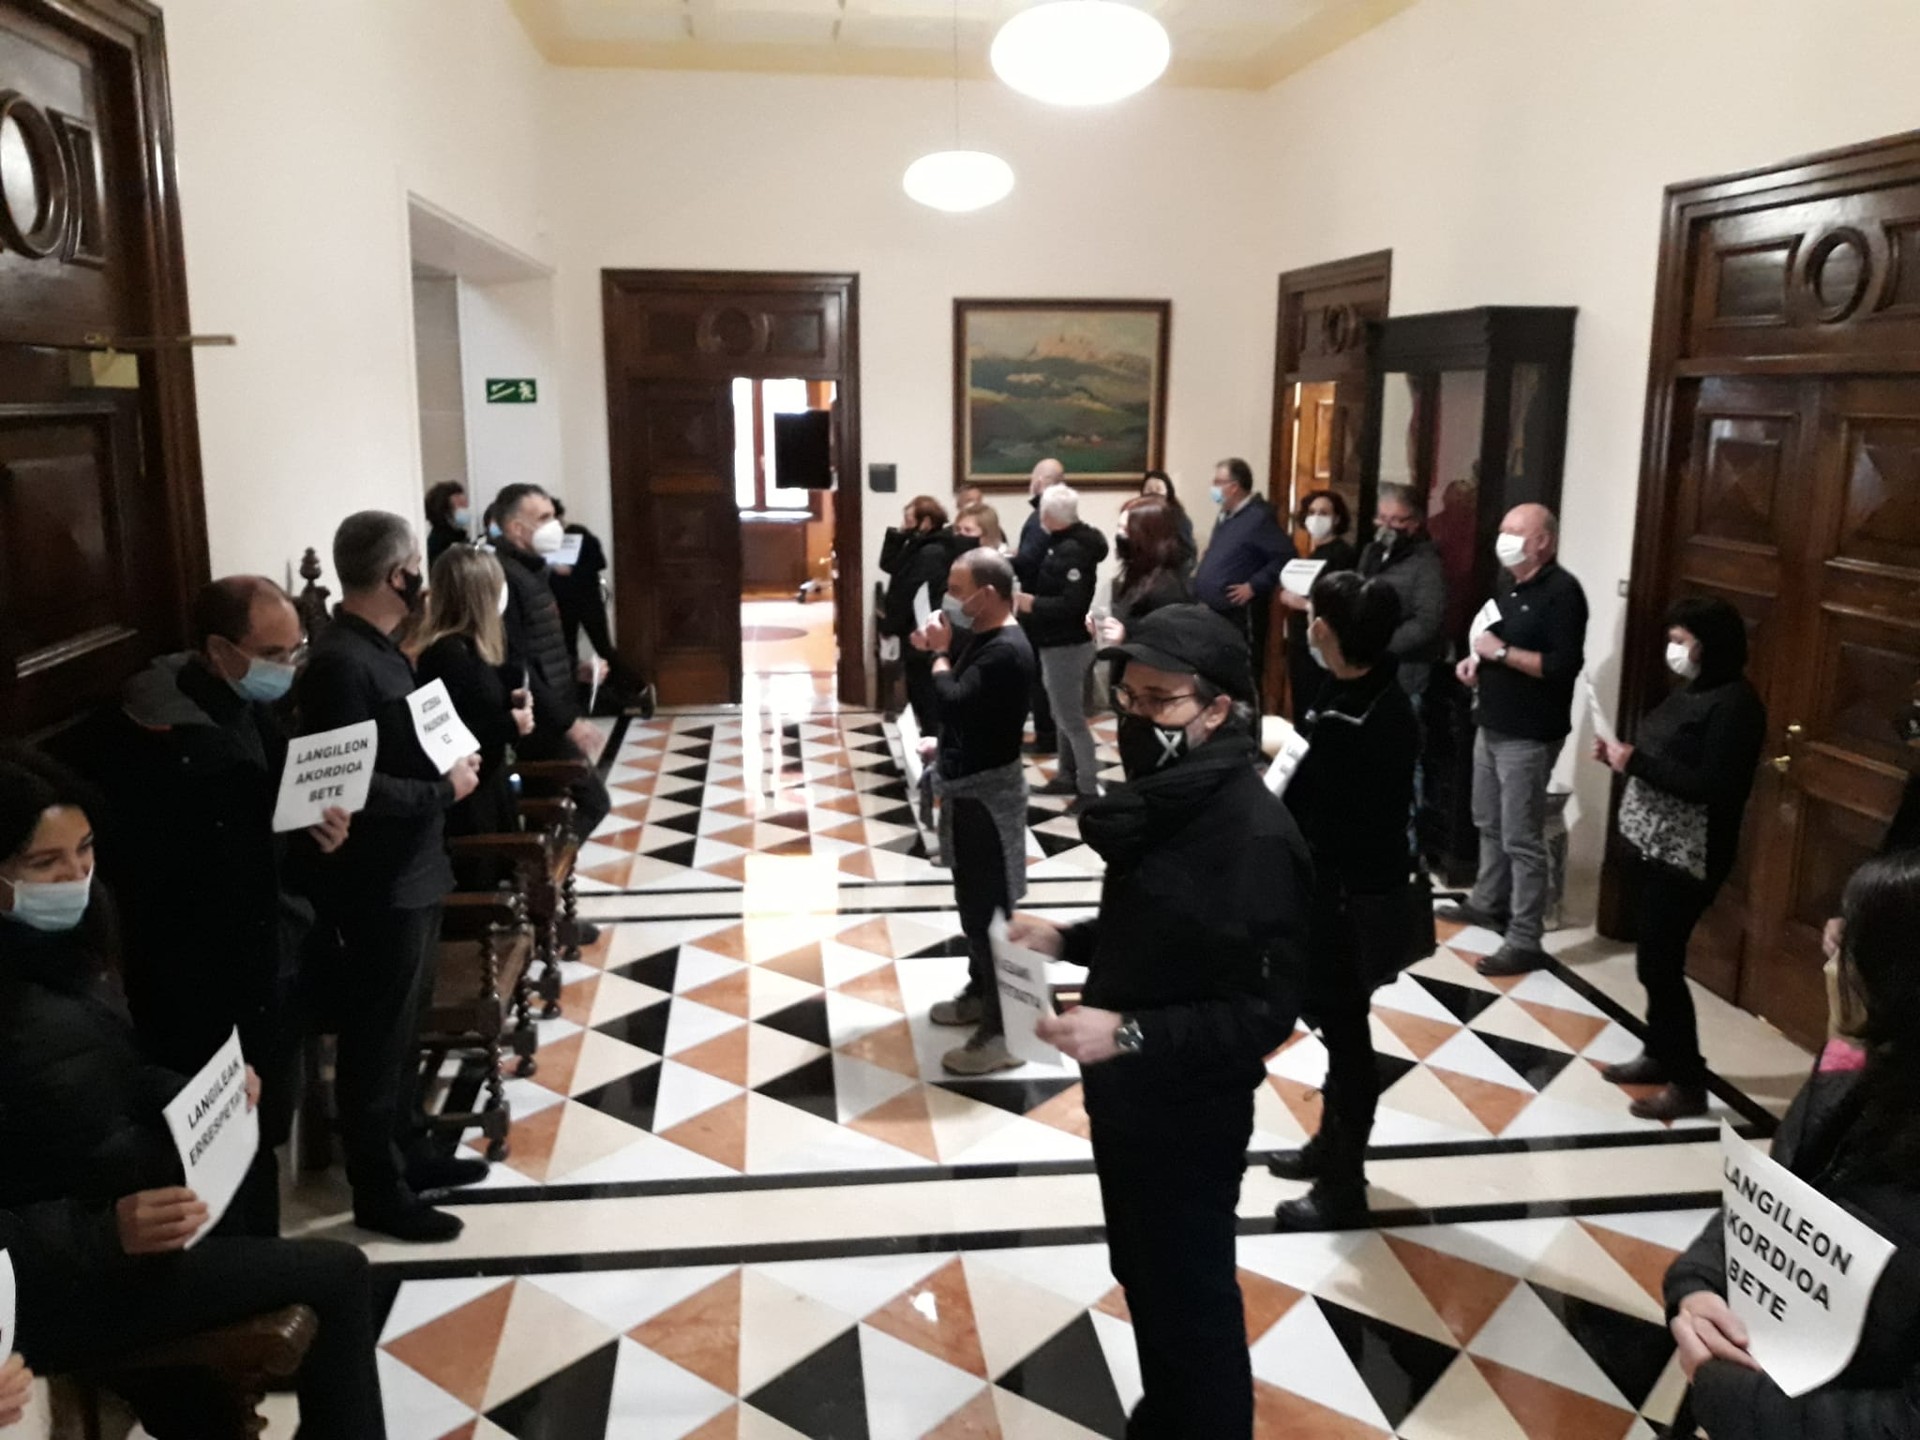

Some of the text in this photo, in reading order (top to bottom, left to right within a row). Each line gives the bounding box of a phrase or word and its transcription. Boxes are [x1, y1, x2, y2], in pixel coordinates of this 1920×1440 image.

[295, 761, 363, 785] AKORDIOA
[296, 737, 369, 764] LANGILEON
[308, 784, 344, 802] BETE
[1724, 1156, 1853, 1276] LANGILEON
[1726, 1208, 1831, 1312] KORDIOA
[1727, 1256, 1787, 1322] BETE
